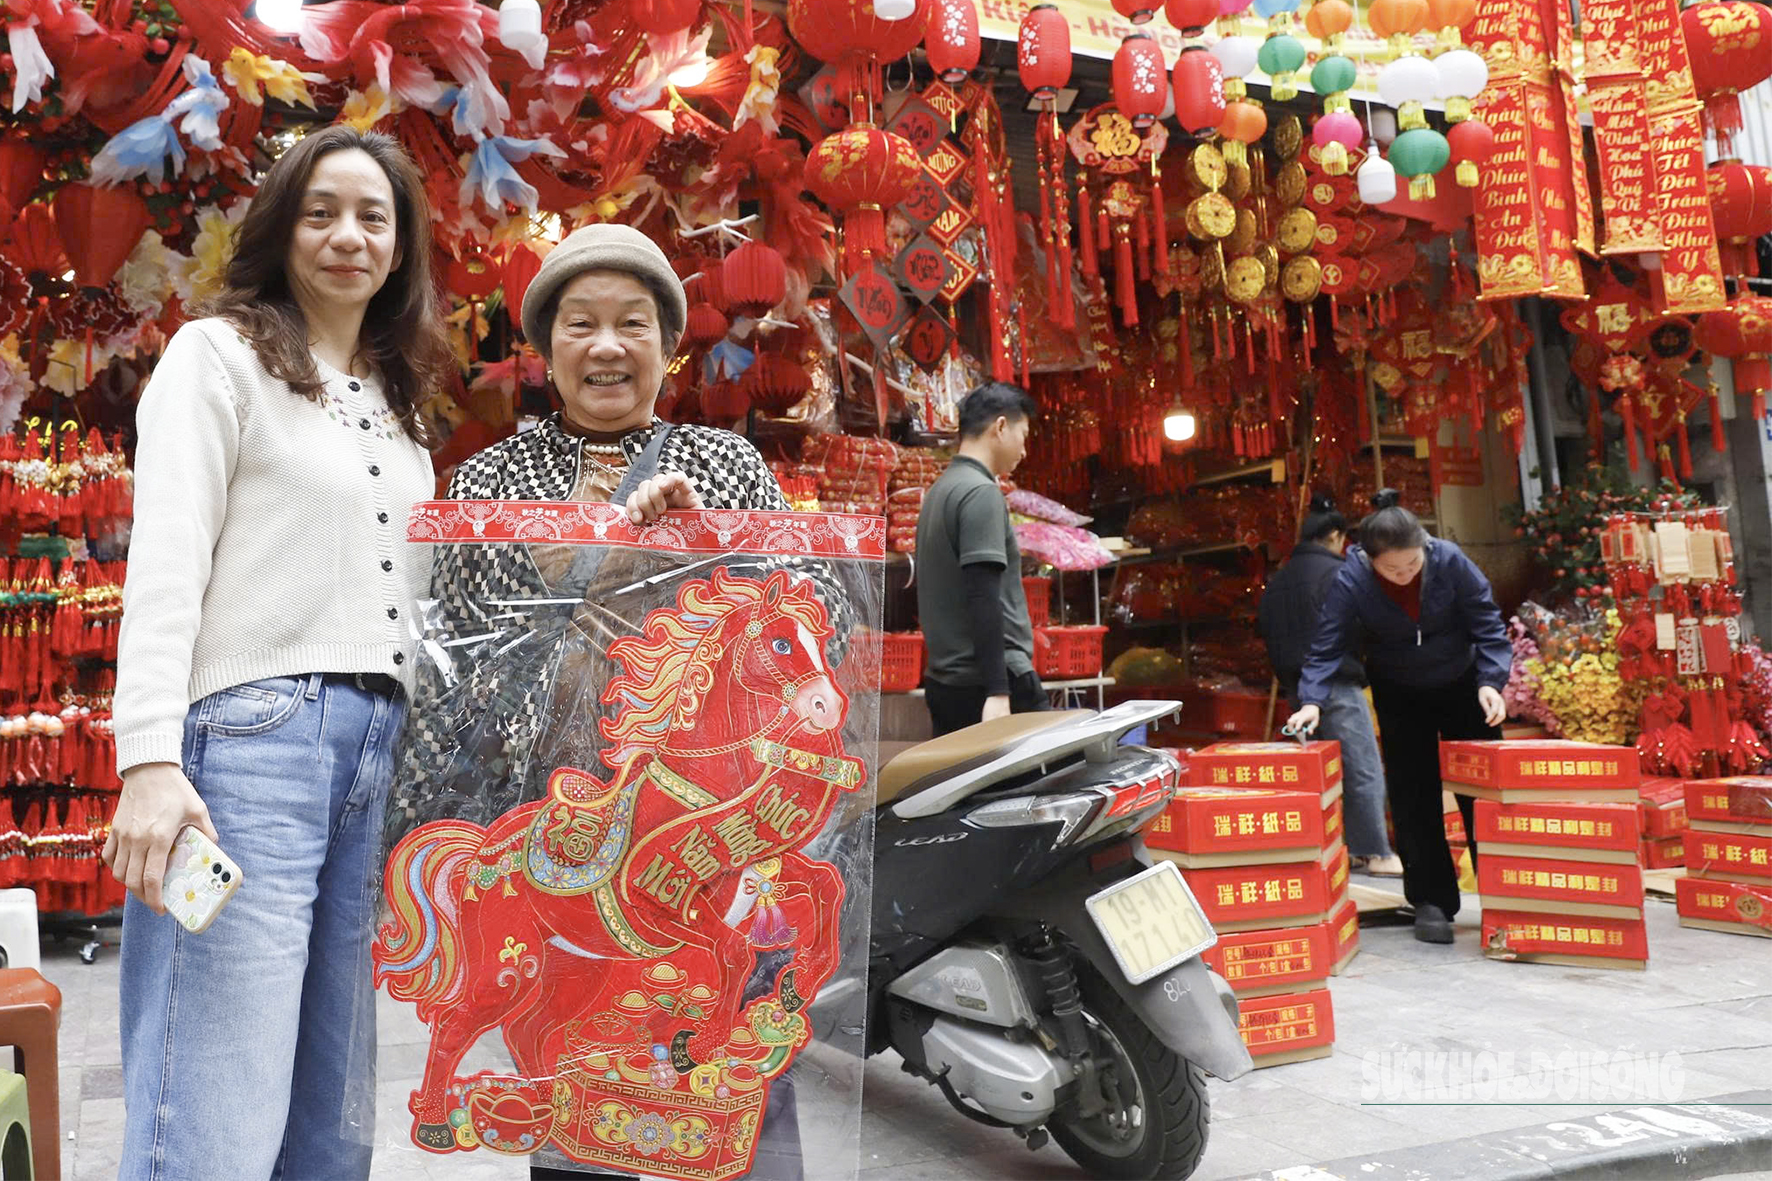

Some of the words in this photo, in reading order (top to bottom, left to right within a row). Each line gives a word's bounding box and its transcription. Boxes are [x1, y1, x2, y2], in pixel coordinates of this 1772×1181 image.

[1656, 174, 1698, 192] Đến
[1657, 153, 1690, 172] Tết
[1491, 209, 1522, 227] An
[547, 805, 603, 862] 福
[711, 808, 773, 868] Mừng
[754, 783, 810, 840] Chúc
[670, 823, 722, 881] Năm
[633, 854, 692, 909] Mới
